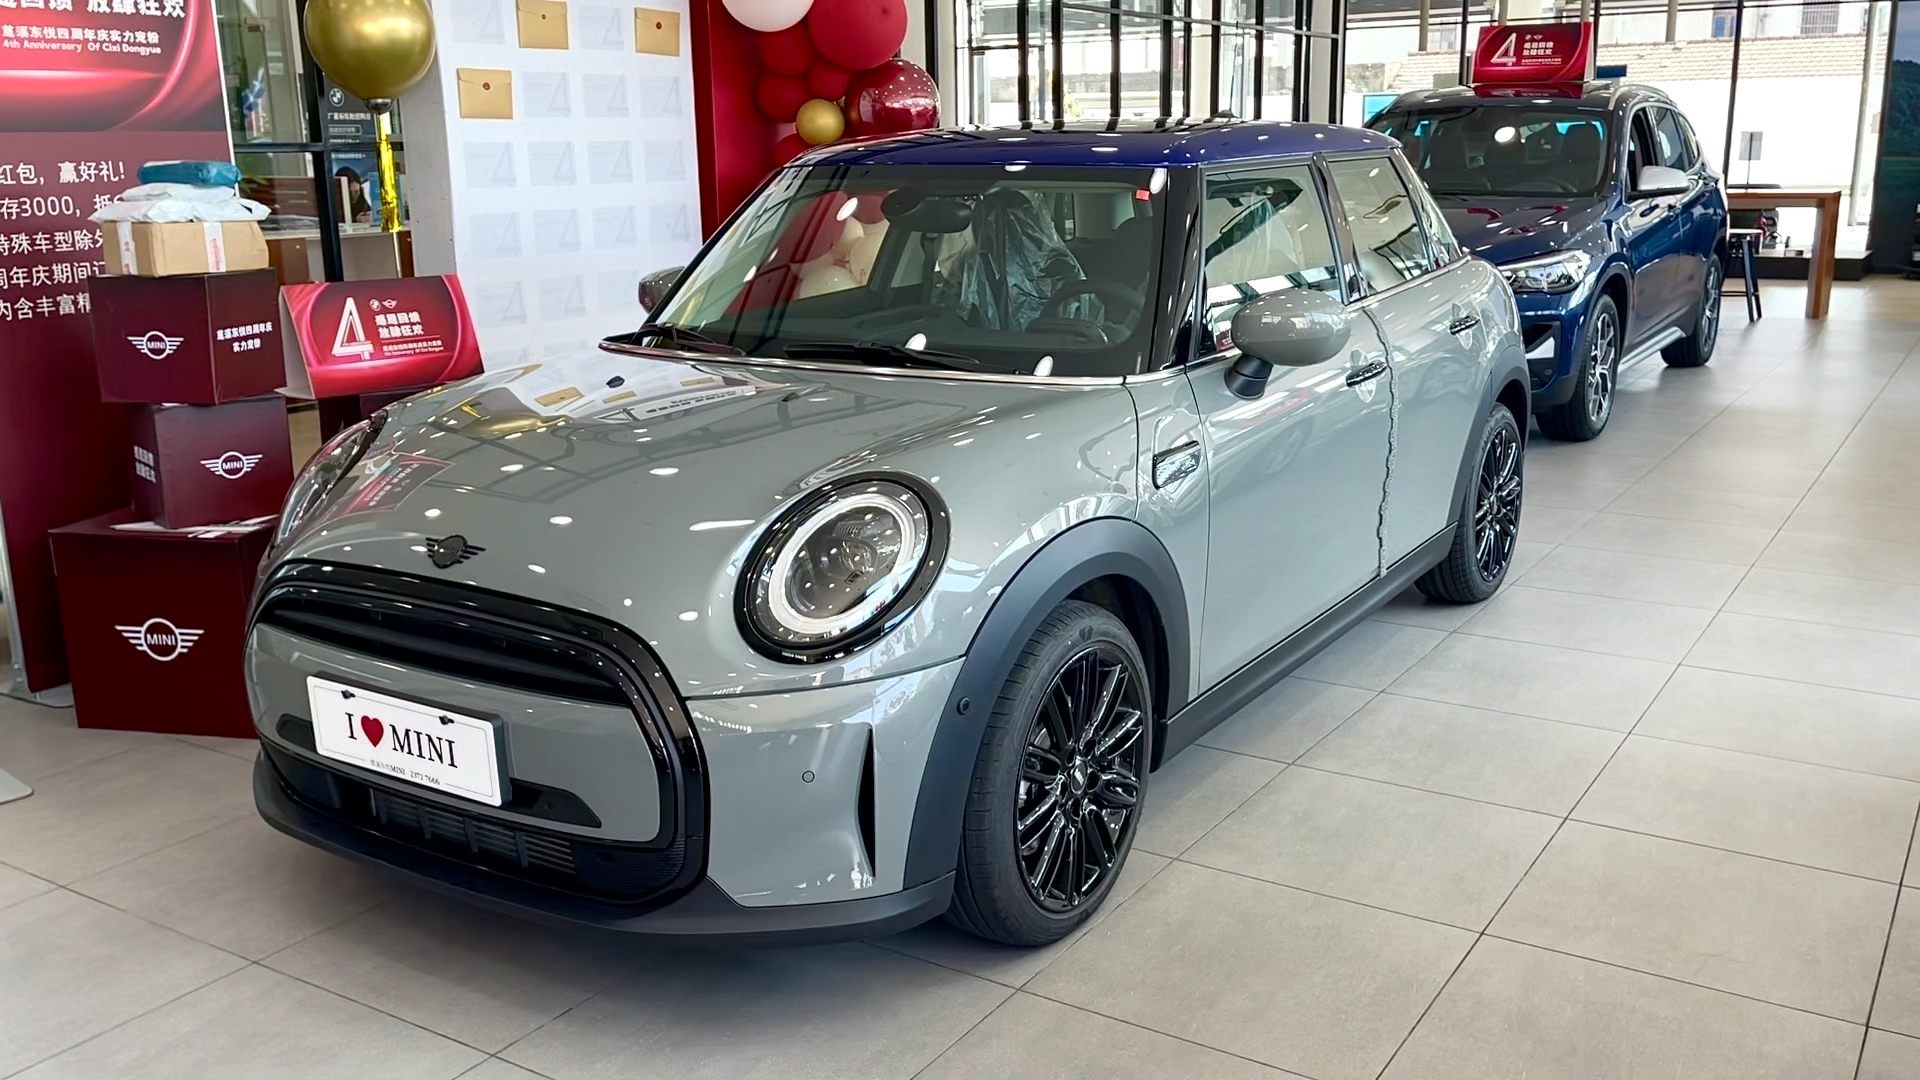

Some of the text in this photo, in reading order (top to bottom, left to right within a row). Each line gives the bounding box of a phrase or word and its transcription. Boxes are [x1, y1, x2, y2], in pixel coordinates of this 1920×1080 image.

[3, 39, 161, 56] 4th Anniversary Of Cixi Dongyue
[331, 296, 375, 360] 4
[146, 633, 176, 647] MINI
[345, 712, 458, 769] I MINI
